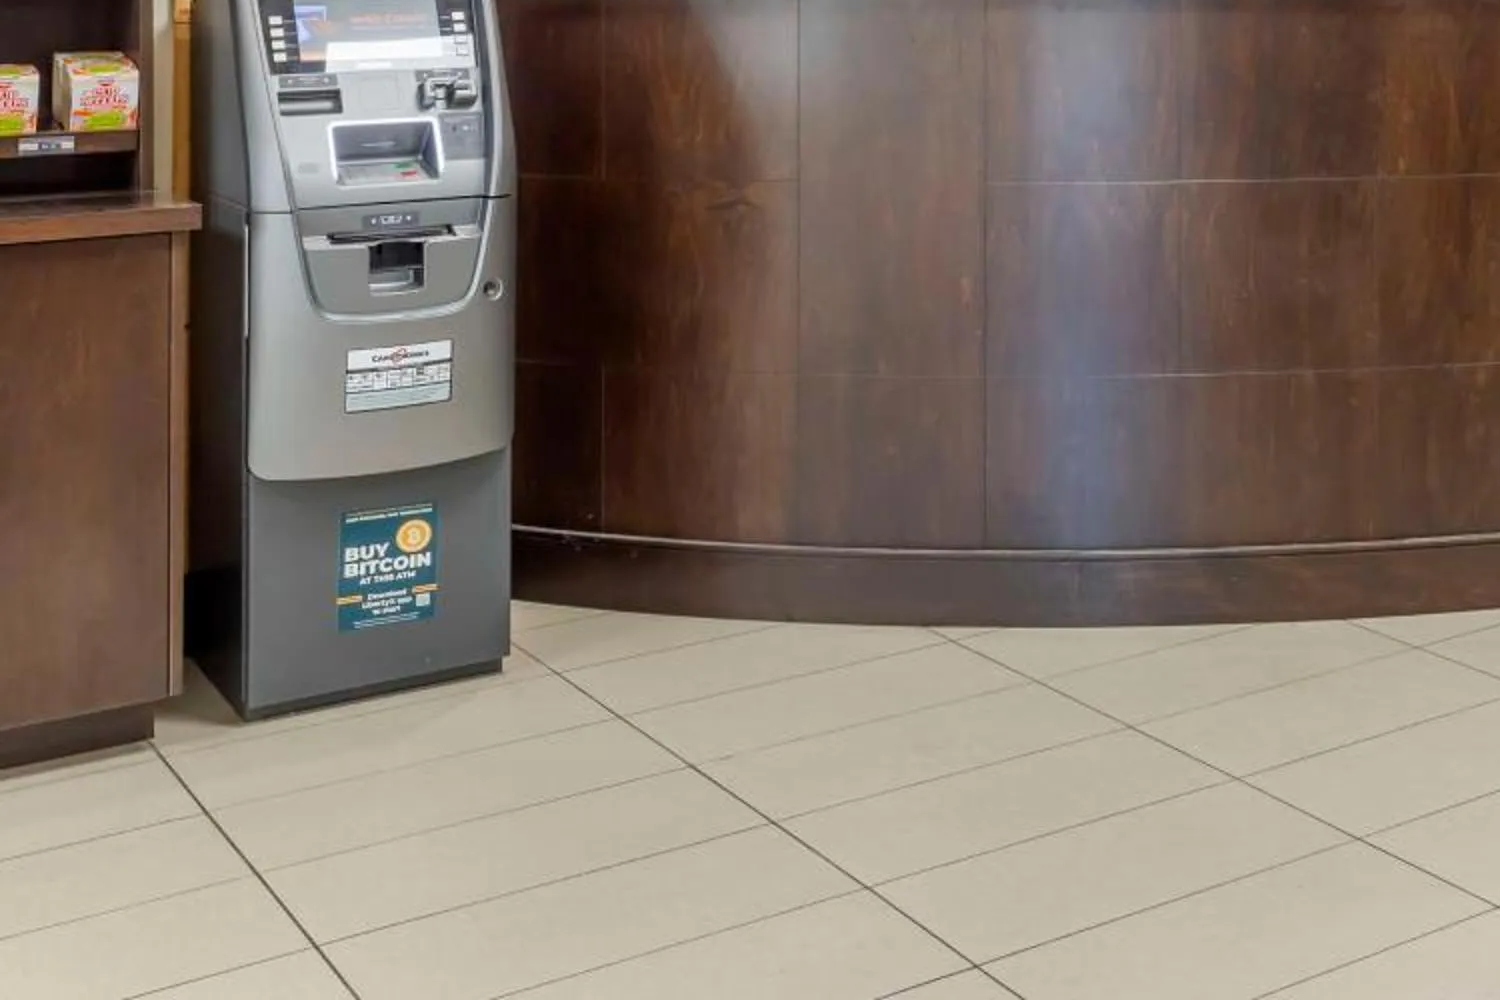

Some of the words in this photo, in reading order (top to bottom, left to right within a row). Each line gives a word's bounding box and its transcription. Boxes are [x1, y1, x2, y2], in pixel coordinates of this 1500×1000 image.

[344, 541, 390, 562] BUY
[343, 551, 432, 579] BITCOIN
[360, 577, 371, 586] AT
[396, 569, 417, 580] ATM
